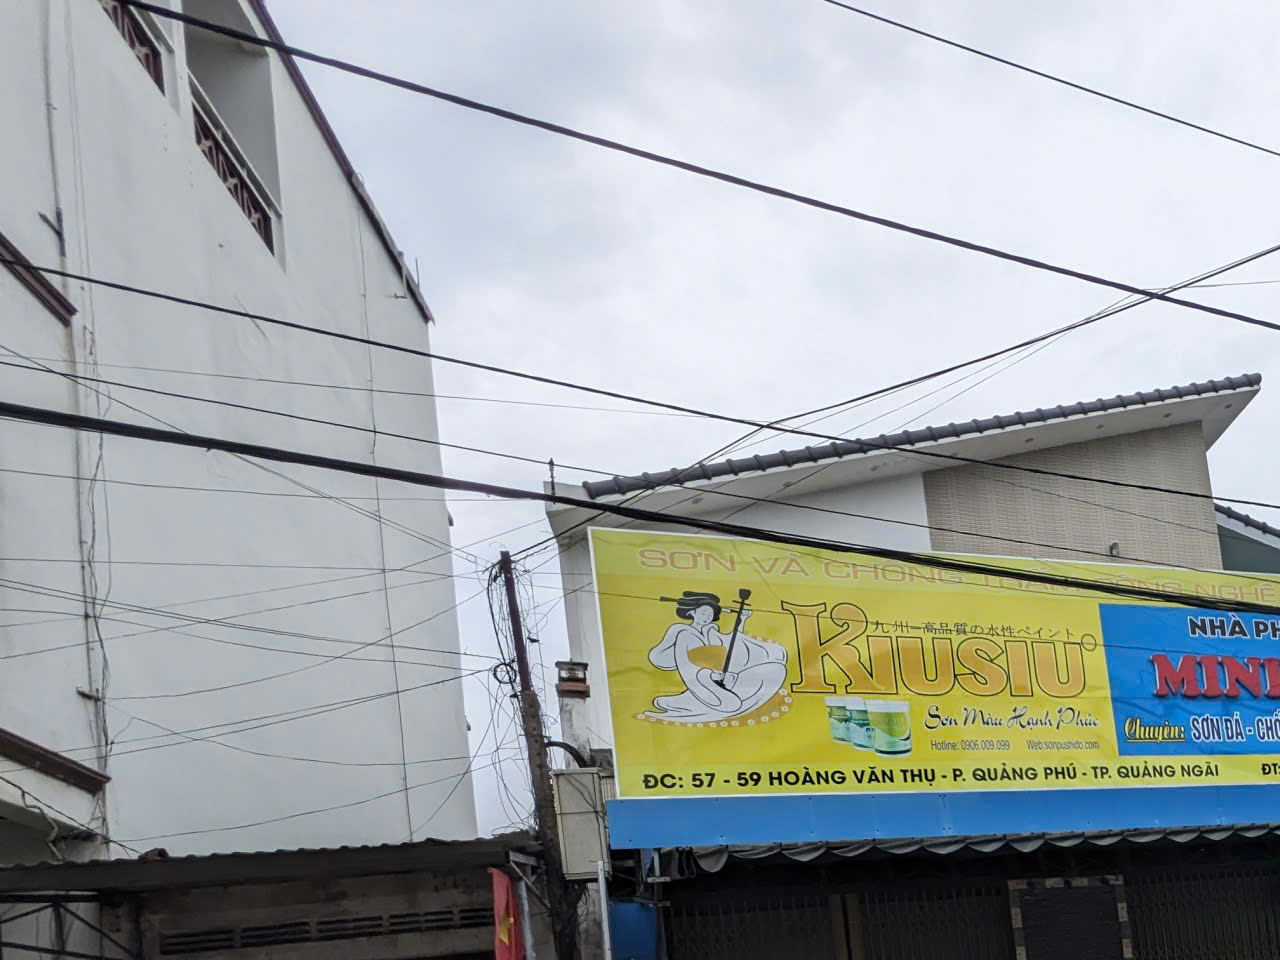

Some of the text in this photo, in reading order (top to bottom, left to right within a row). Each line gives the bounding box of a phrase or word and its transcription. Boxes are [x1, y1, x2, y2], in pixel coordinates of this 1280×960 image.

[639, 549, 737, 572] SƠN
[752, 552, 810, 577] VÀ
[1188, 613, 1249, 638] NHÀ
[925, 705, 958, 729] Sơn
[963, 707, 1002, 726] Màu
[1007, 705, 1052, 730] Hạnh
[1056, 706, 1099, 730] Phúc
[1124, 717, 1186, 744] Chuyên:
[1190, 714, 1223, 741] SƠN
[1224, 712, 1246, 742] ĐÁ
[930, 739, 959, 751] Hotline:
[643, 773, 684, 789] ĐC:
[691, 772, 716, 788] 57
[737, 771, 762, 787] 59
[769, 766, 847, 787] HOÀNG
[852, 766, 894, 784] VĂN
[900, 768, 935, 787] THỤ
[953, 769, 966, 782] P.
[972, 763, 1038, 782] QUẢNG
[1044, 763, 1077, 780] PHÚ
[1091, 766, 1112, 780] TP.
[1117, 761, 1176, 778] QUẢNG
[1181, 764, 1219, 777] NGÃI
[1261, 763, 1280, 775] ĐT:
